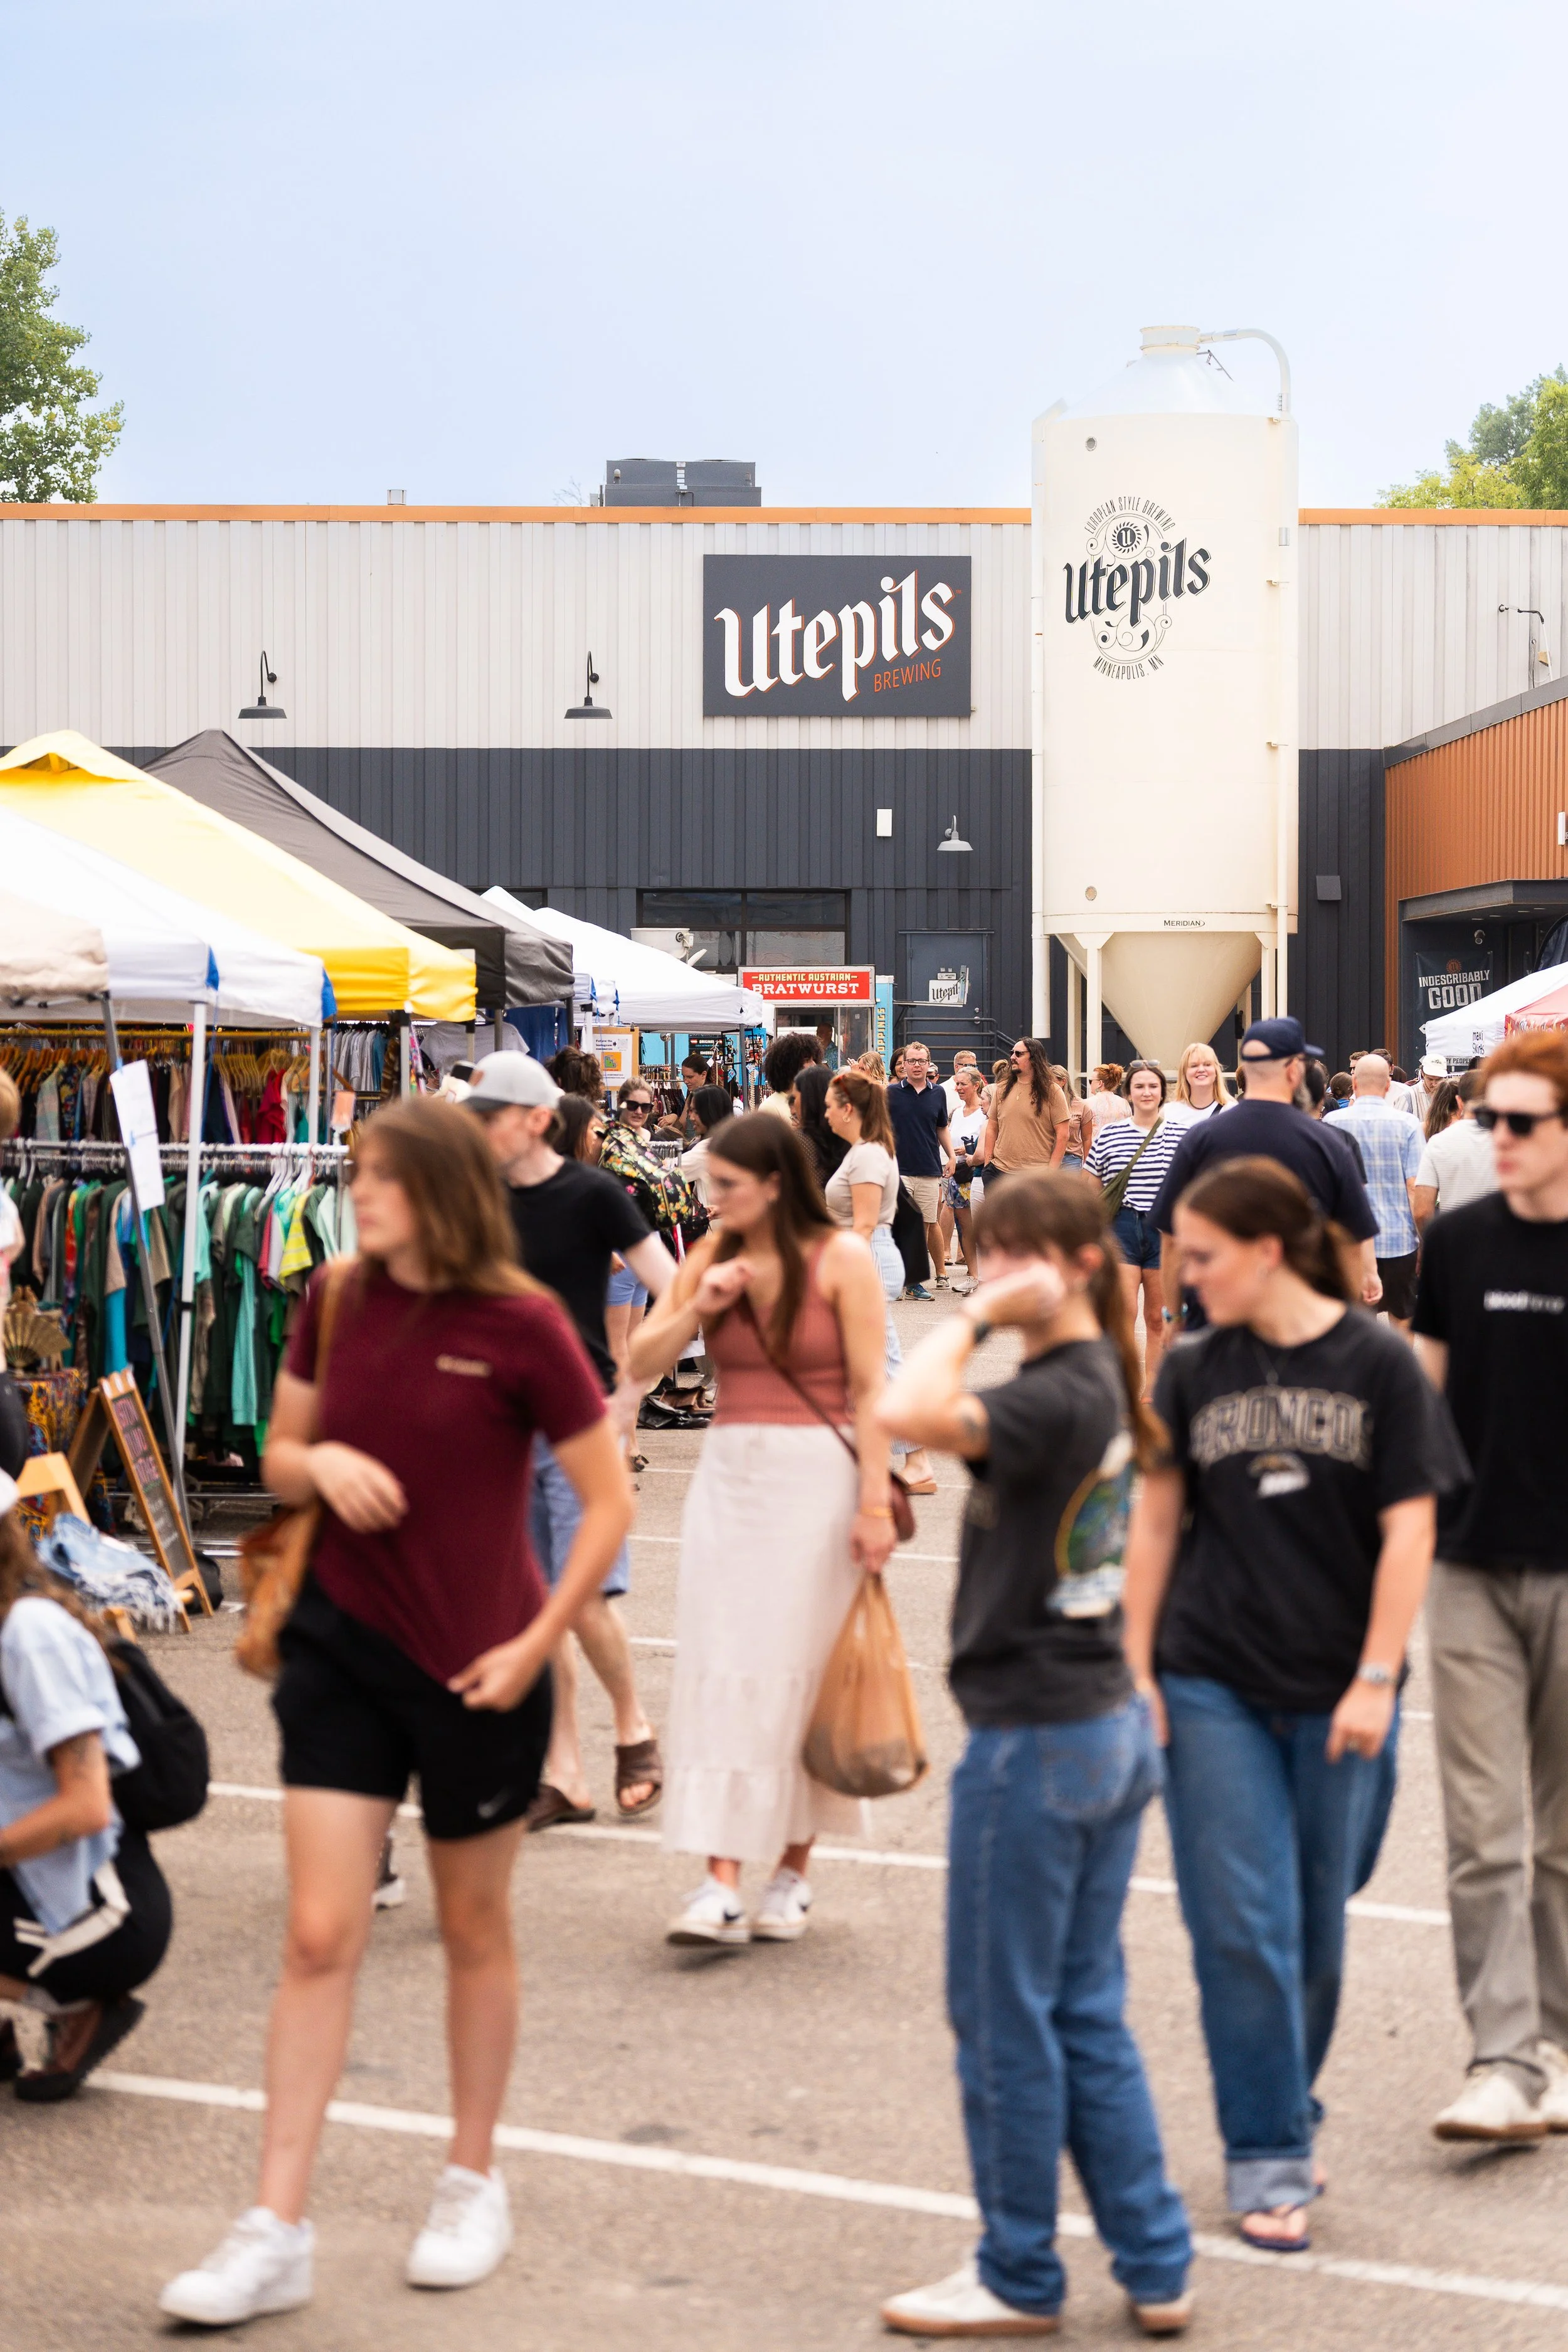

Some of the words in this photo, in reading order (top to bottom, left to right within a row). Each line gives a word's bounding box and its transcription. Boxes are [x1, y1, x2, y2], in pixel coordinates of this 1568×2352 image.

[1084, 499, 1116, 534] EUROPEAN
[1118, 496, 1141, 511] STYLE
[1142, 500, 1175, 531] BREWING
[1062, 537, 1212, 628] Utepils
[714, 569, 956, 702] Utepils
[874, 658, 941, 693] BREWING
[1148, 654, 1164, 671] MN
[752, 983, 859, 995] BRATWURST
[758, 973, 806, 982] AUTHENTIC
[808, 973, 852, 982] AUSTRIAN
[1419, 969, 1490, 988] INDESCRIBABLY
[1428, 983, 1482, 1009] GOOD
